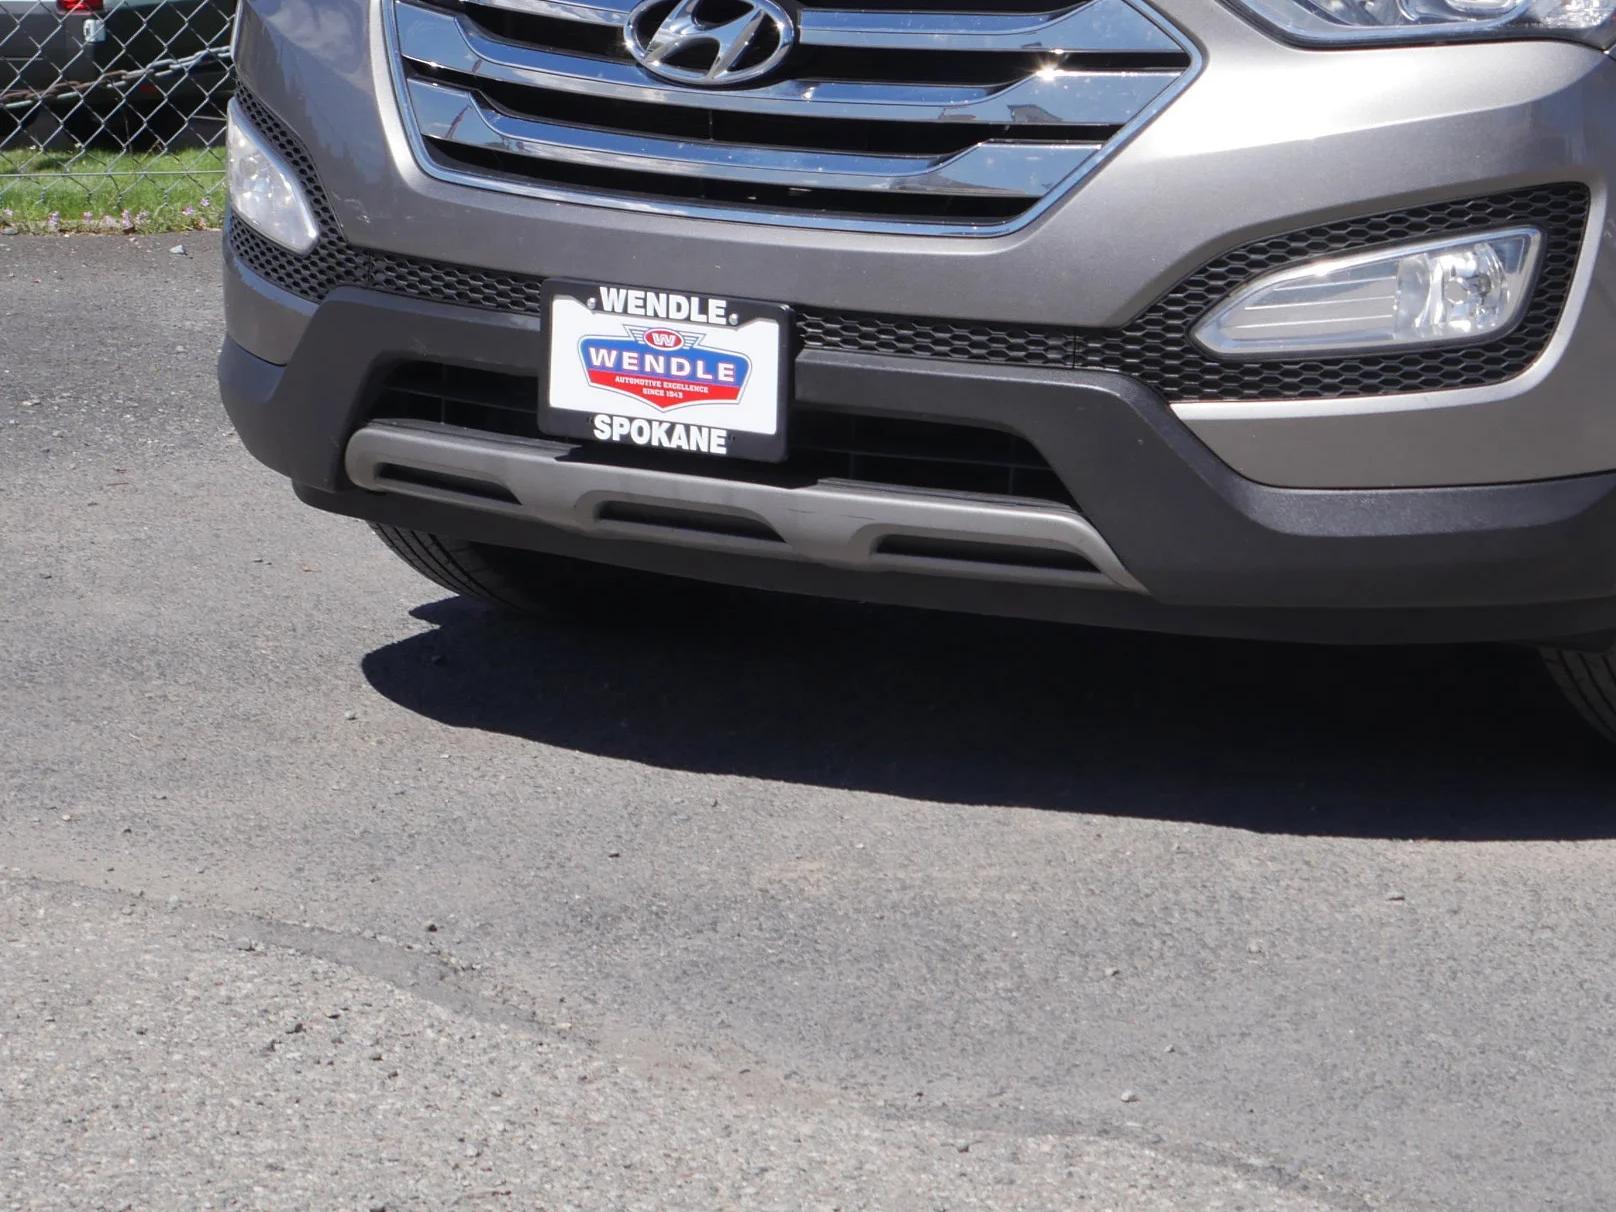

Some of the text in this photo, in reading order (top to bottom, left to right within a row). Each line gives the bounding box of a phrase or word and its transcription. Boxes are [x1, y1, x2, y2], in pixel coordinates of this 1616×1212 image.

[600, 287, 727, 325] WENDLE
[589, 347, 735, 382] WENDLE
[615, 376, 709, 394] AUTOMOTIVE EXCELLENCE
[642, 387, 665, 397] SINCE
[593, 414, 727, 455] SPOKANE
